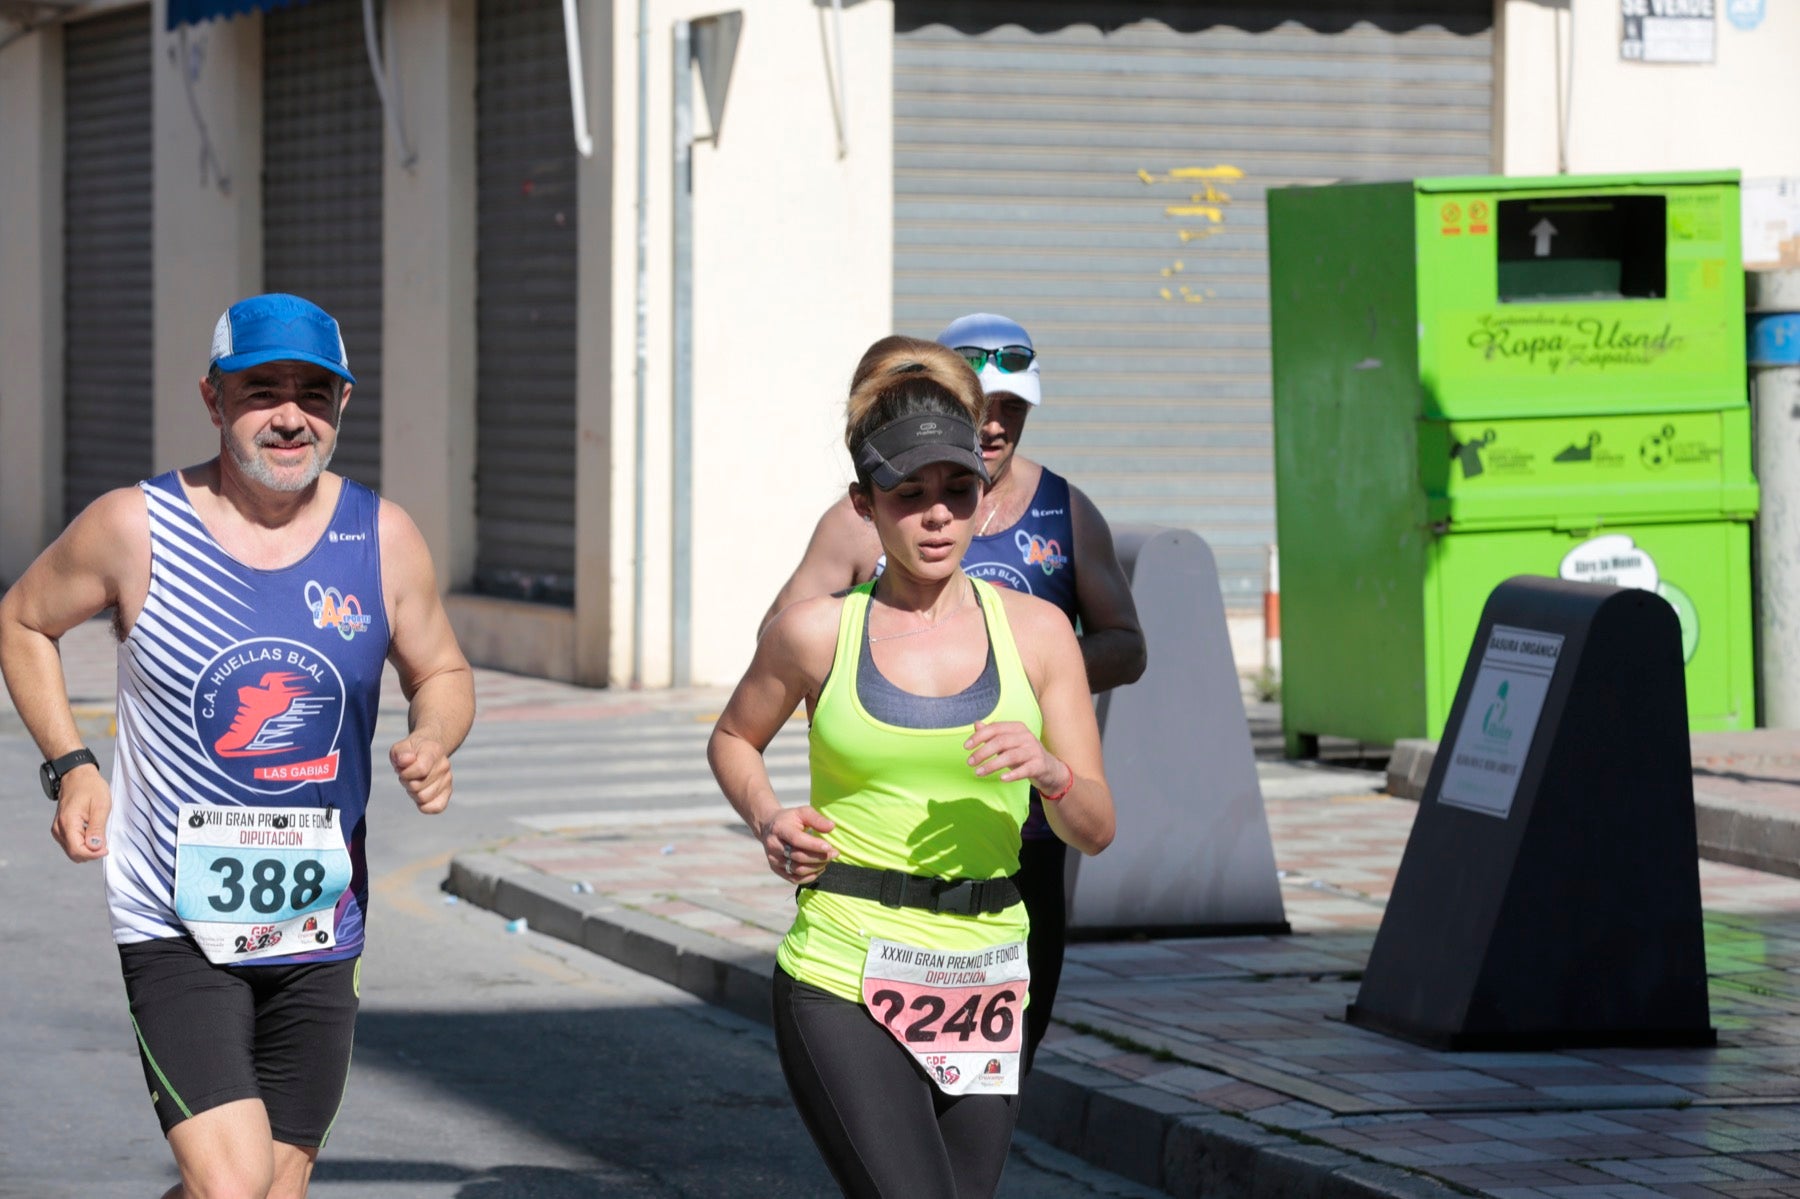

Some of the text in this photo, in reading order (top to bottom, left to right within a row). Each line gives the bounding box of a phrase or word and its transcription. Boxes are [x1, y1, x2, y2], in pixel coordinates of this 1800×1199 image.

[1467, 328, 1563, 364] Ropa
[339, 532, 366, 542] Cervi
[213, 647, 282, 685] HUELLAS
[286, 650, 325, 683] BLAL
[263, 764, 330, 779] LAS GABIAS
[225, 812, 255, 828] GRAN
[299, 815, 310, 829] DE
[240, 829, 303, 846] DIPUTACIÓN
[207, 857, 326, 914] 388
[880, 945, 1019, 970] XXXIII GRAN PREMIO DE FONDO
[925, 970, 987, 984] DIPUTACIÓN
[871, 989, 1017, 1042] 2246
